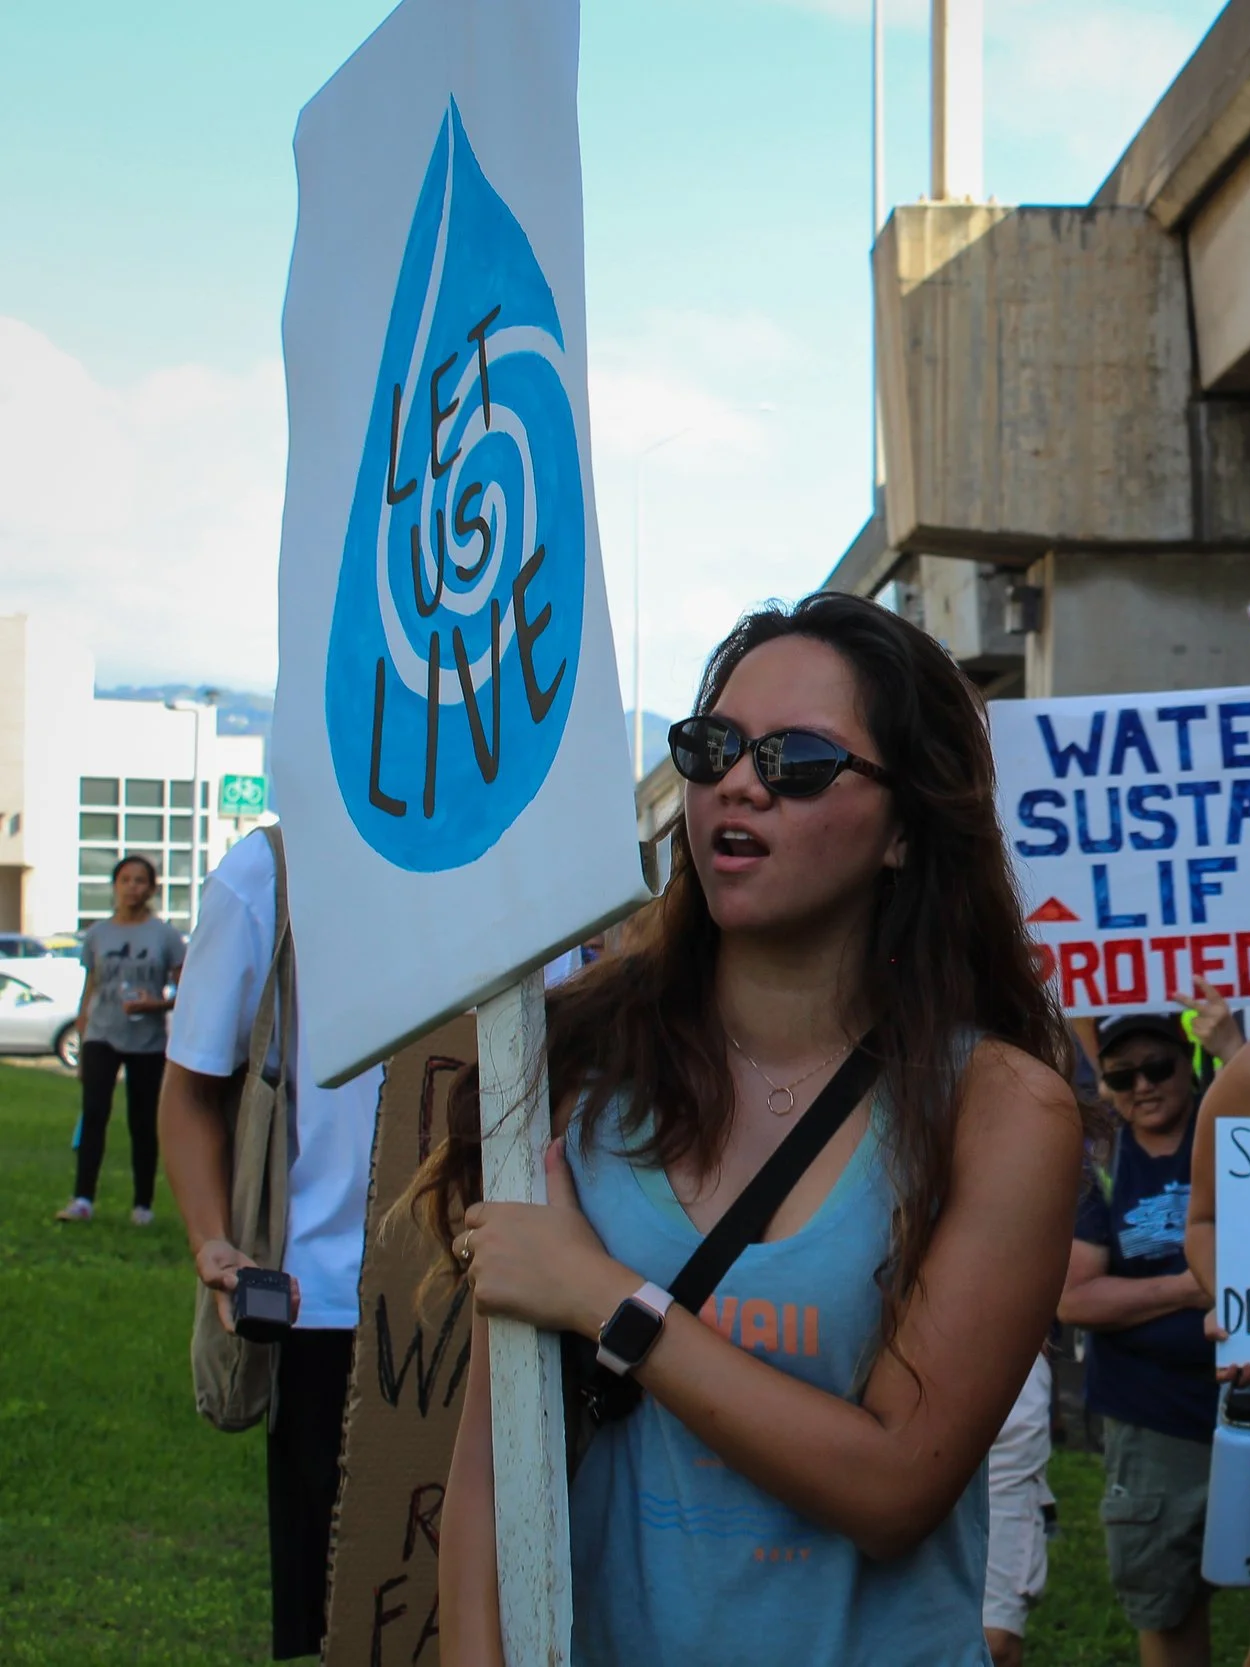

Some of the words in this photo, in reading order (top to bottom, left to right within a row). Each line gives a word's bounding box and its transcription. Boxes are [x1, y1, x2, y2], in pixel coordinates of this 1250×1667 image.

[386, 304, 502, 506] LET
[409, 481, 493, 618] US
[368, 544, 568, 819] LIVE
